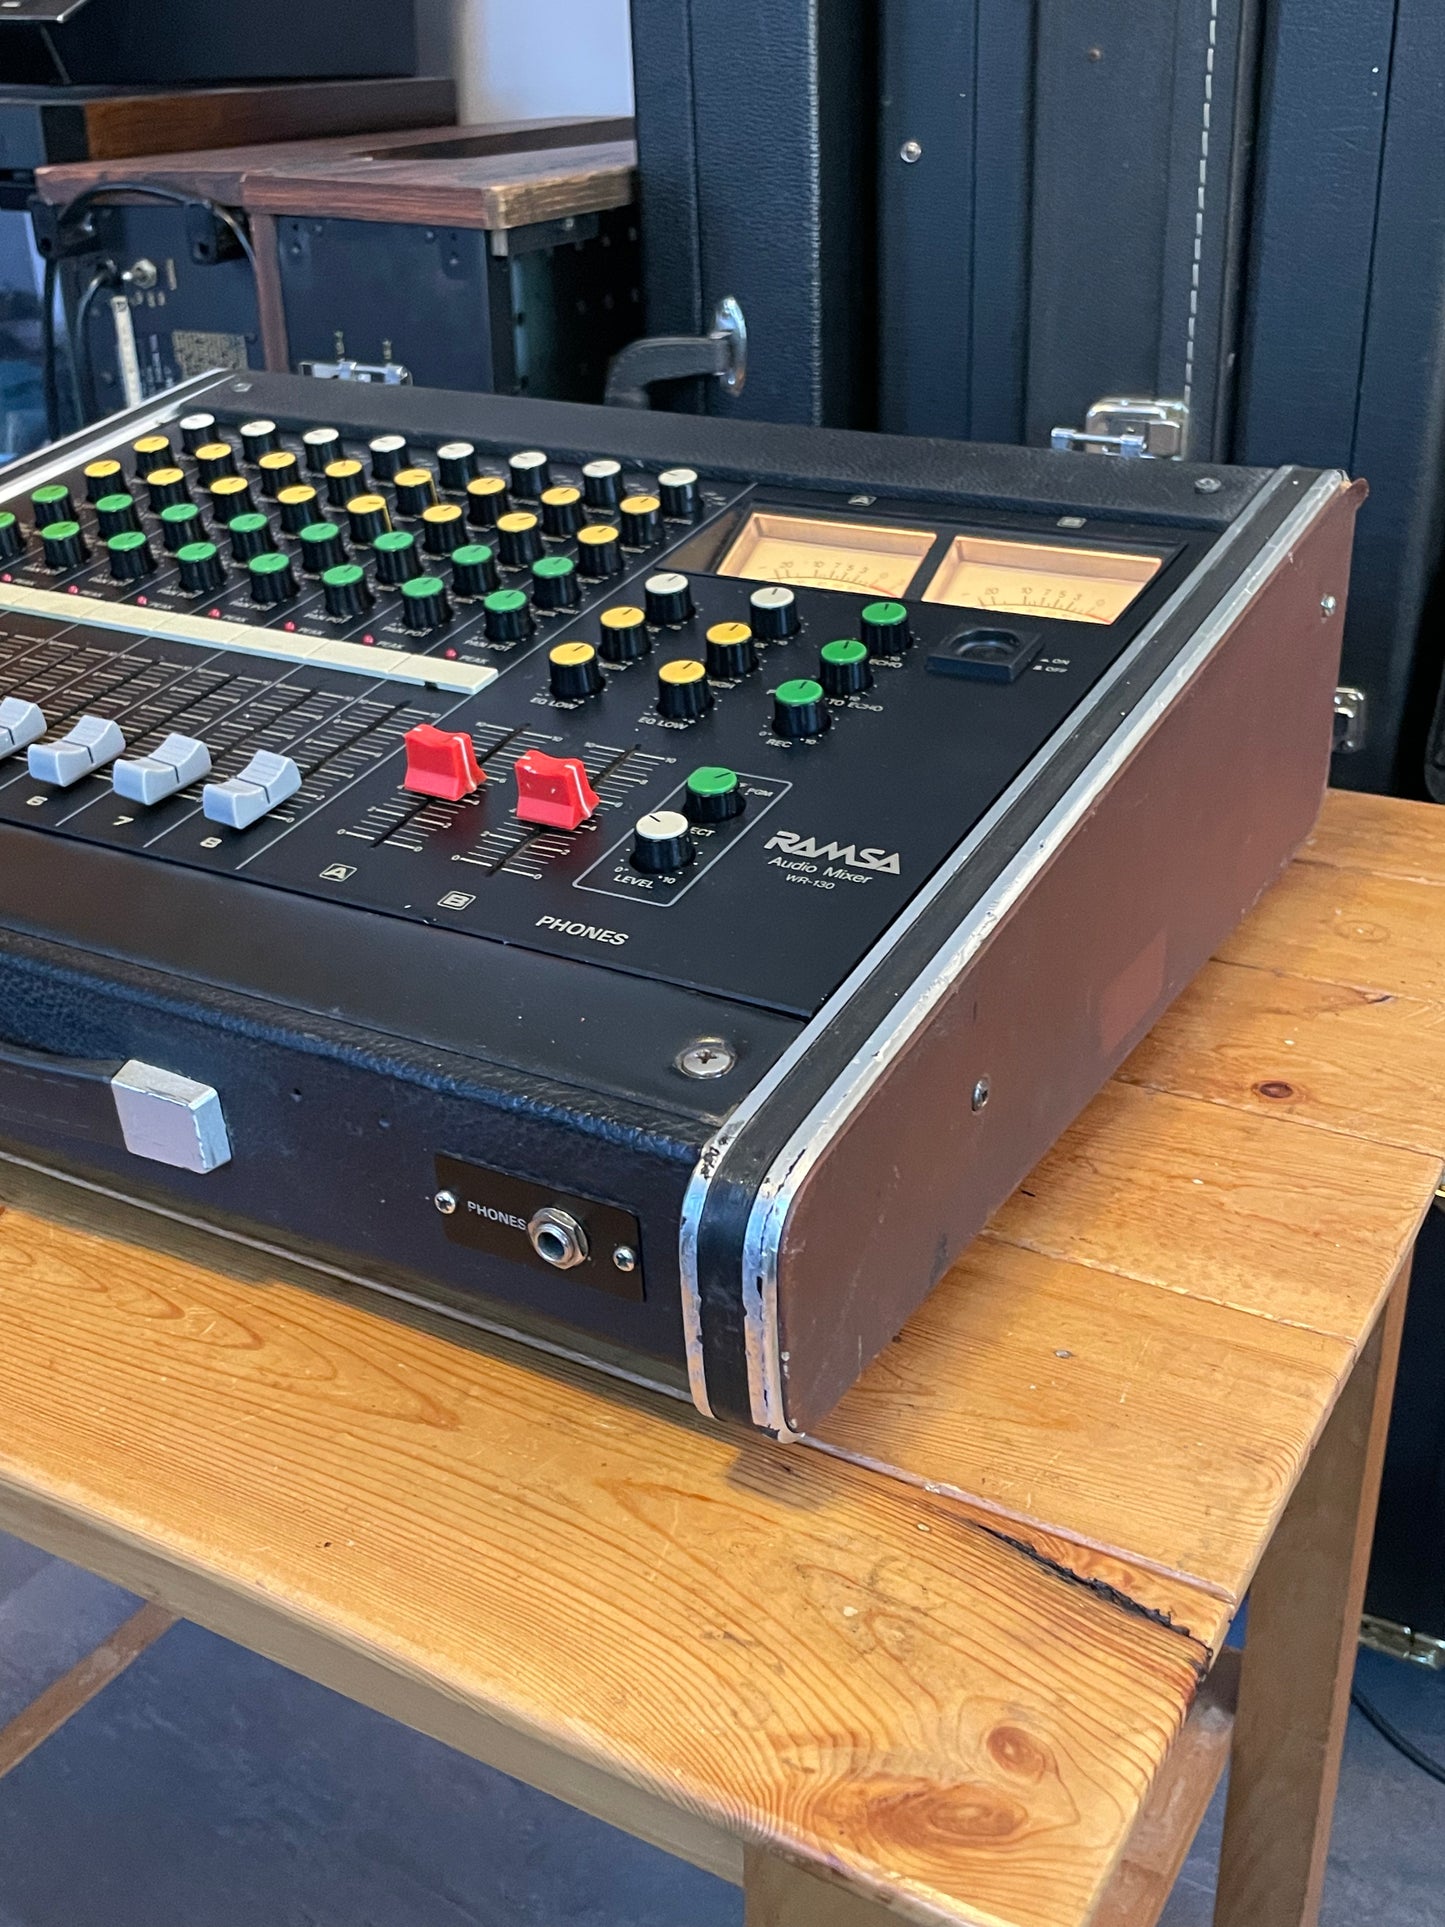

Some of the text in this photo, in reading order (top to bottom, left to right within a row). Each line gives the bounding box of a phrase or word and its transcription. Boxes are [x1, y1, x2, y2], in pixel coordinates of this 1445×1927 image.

[459, 654, 489, 664] PEAK
[869, 658, 903, 668] ECHO
[530, 697, 579, 710] EQ LOW
[848, 702, 884, 712] ECHO
[637, 716, 689, 730] EQ LOW
[766, 738, 793, 748] REC
[748, 787, 774, 797] PGM
[26, 795, 48, 807] 6
[112, 815, 135, 826] 7
[690, 826, 716, 837] ECT
[200, 836, 223, 848] 8
[764, 830, 900, 875] RAMSA
[768, 856, 873, 884] Audio Mixer
[613, 874, 654, 889] LEVEL
[661, 876, 676, 885] 10
[785, 873, 836, 890] WR-130
[535, 915, 629, 945] PHONES
[467, 1200, 528, 1231] PHONES
